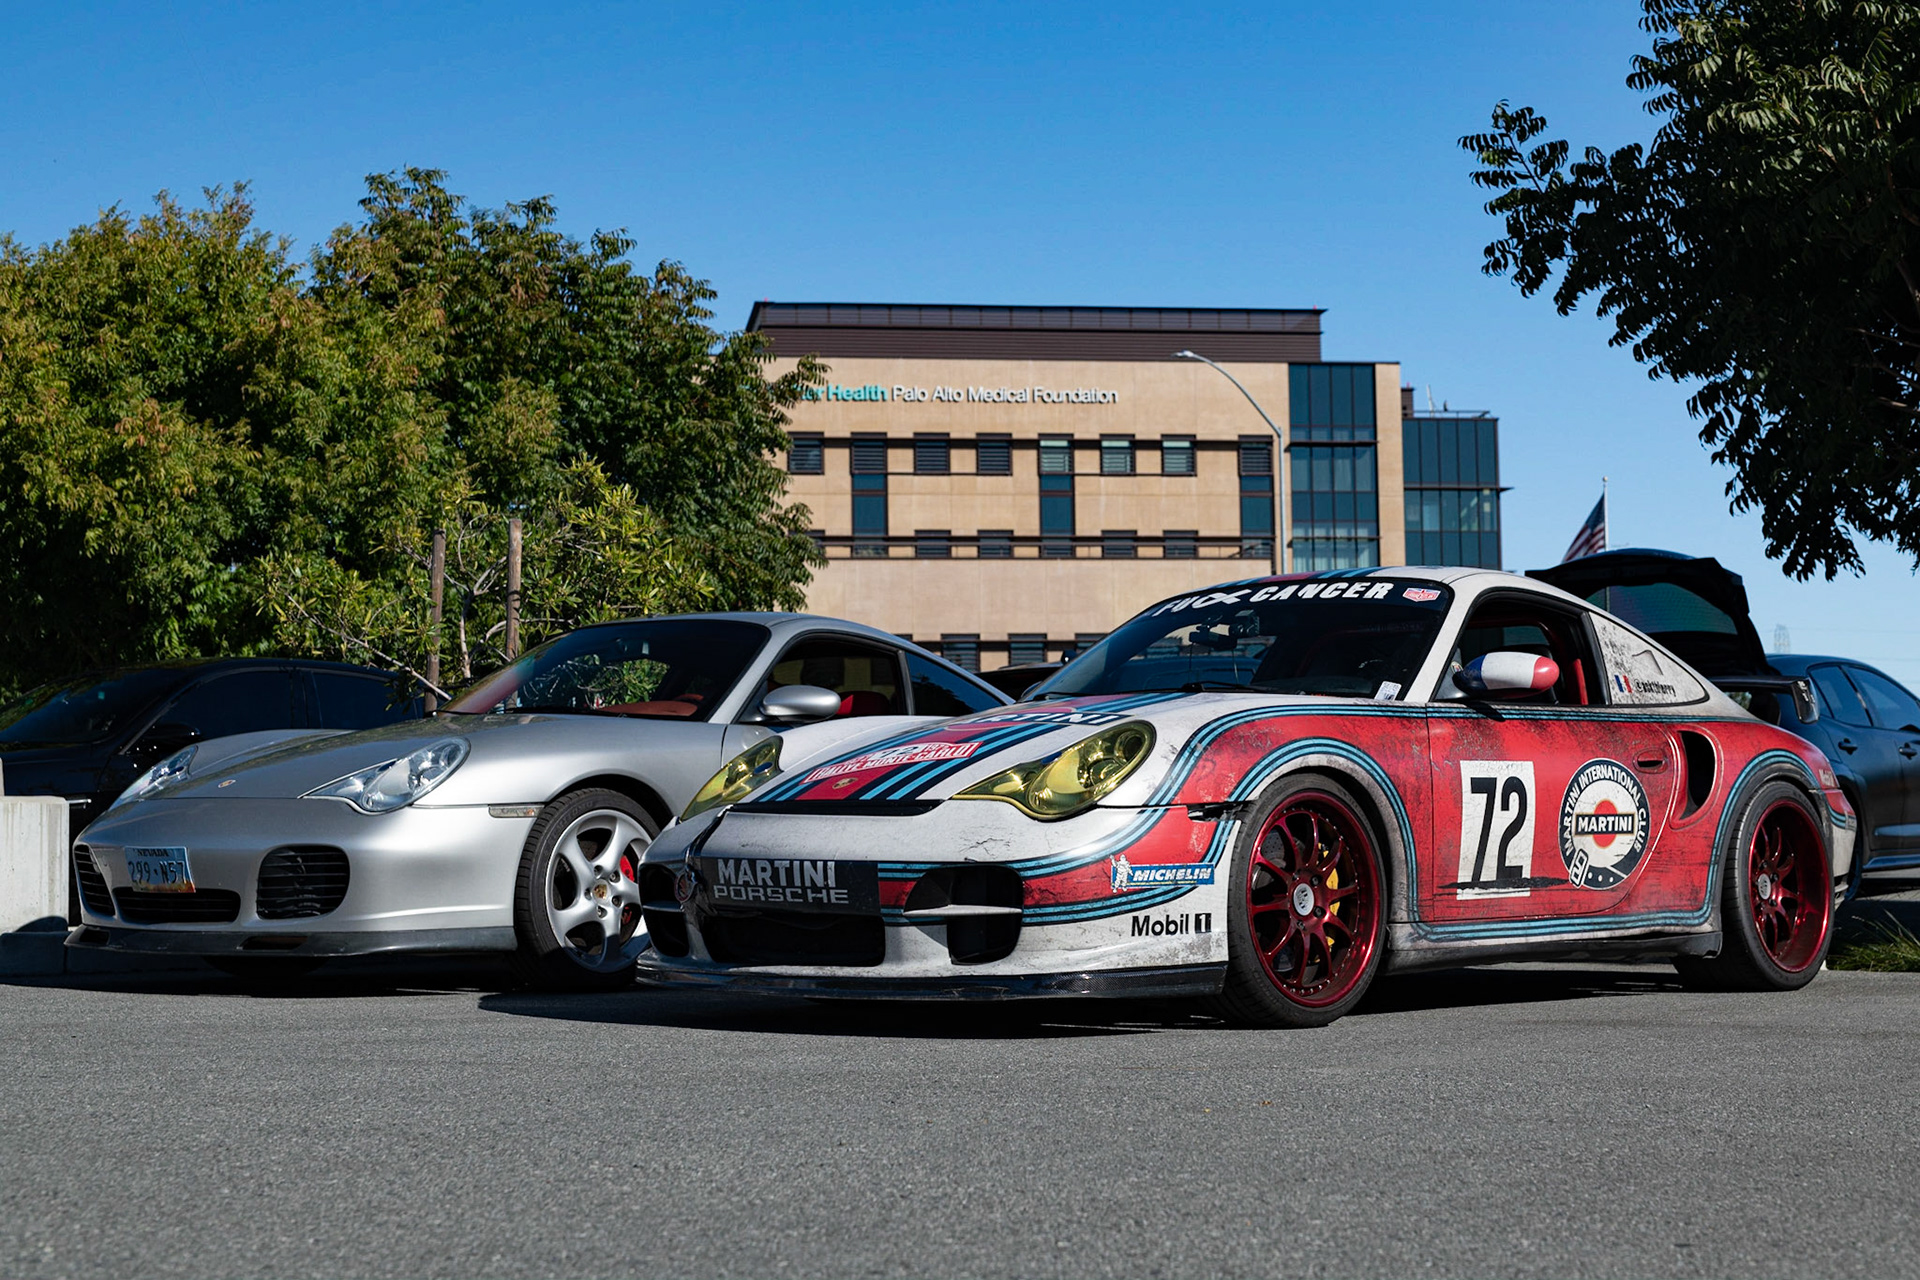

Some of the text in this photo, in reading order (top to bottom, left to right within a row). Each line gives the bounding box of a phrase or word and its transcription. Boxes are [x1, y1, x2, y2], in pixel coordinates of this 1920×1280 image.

[827, 384, 888, 401] Health
[892, 385, 928, 402] Palo
[932, 385, 964, 402] Alto
[967, 386, 1030, 403] Medical
[1033, 386, 1119, 404] Foundation
[1249, 582, 1395, 603] CANCER
[1563, 764, 1647, 857] MARTINI INTERNATIONAL CLUB
[1470, 775, 1528, 885] 72
[1577, 815, 1633, 832] MARTINI
[137, 848, 169, 857] NEVADA
[717, 858, 836, 888] MARTINI
[1132, 867, 1212, 882] MICHELIN
[713, 885, 849, 904] PORSCHE
[1131, 913, 1189, 937] Mobil
